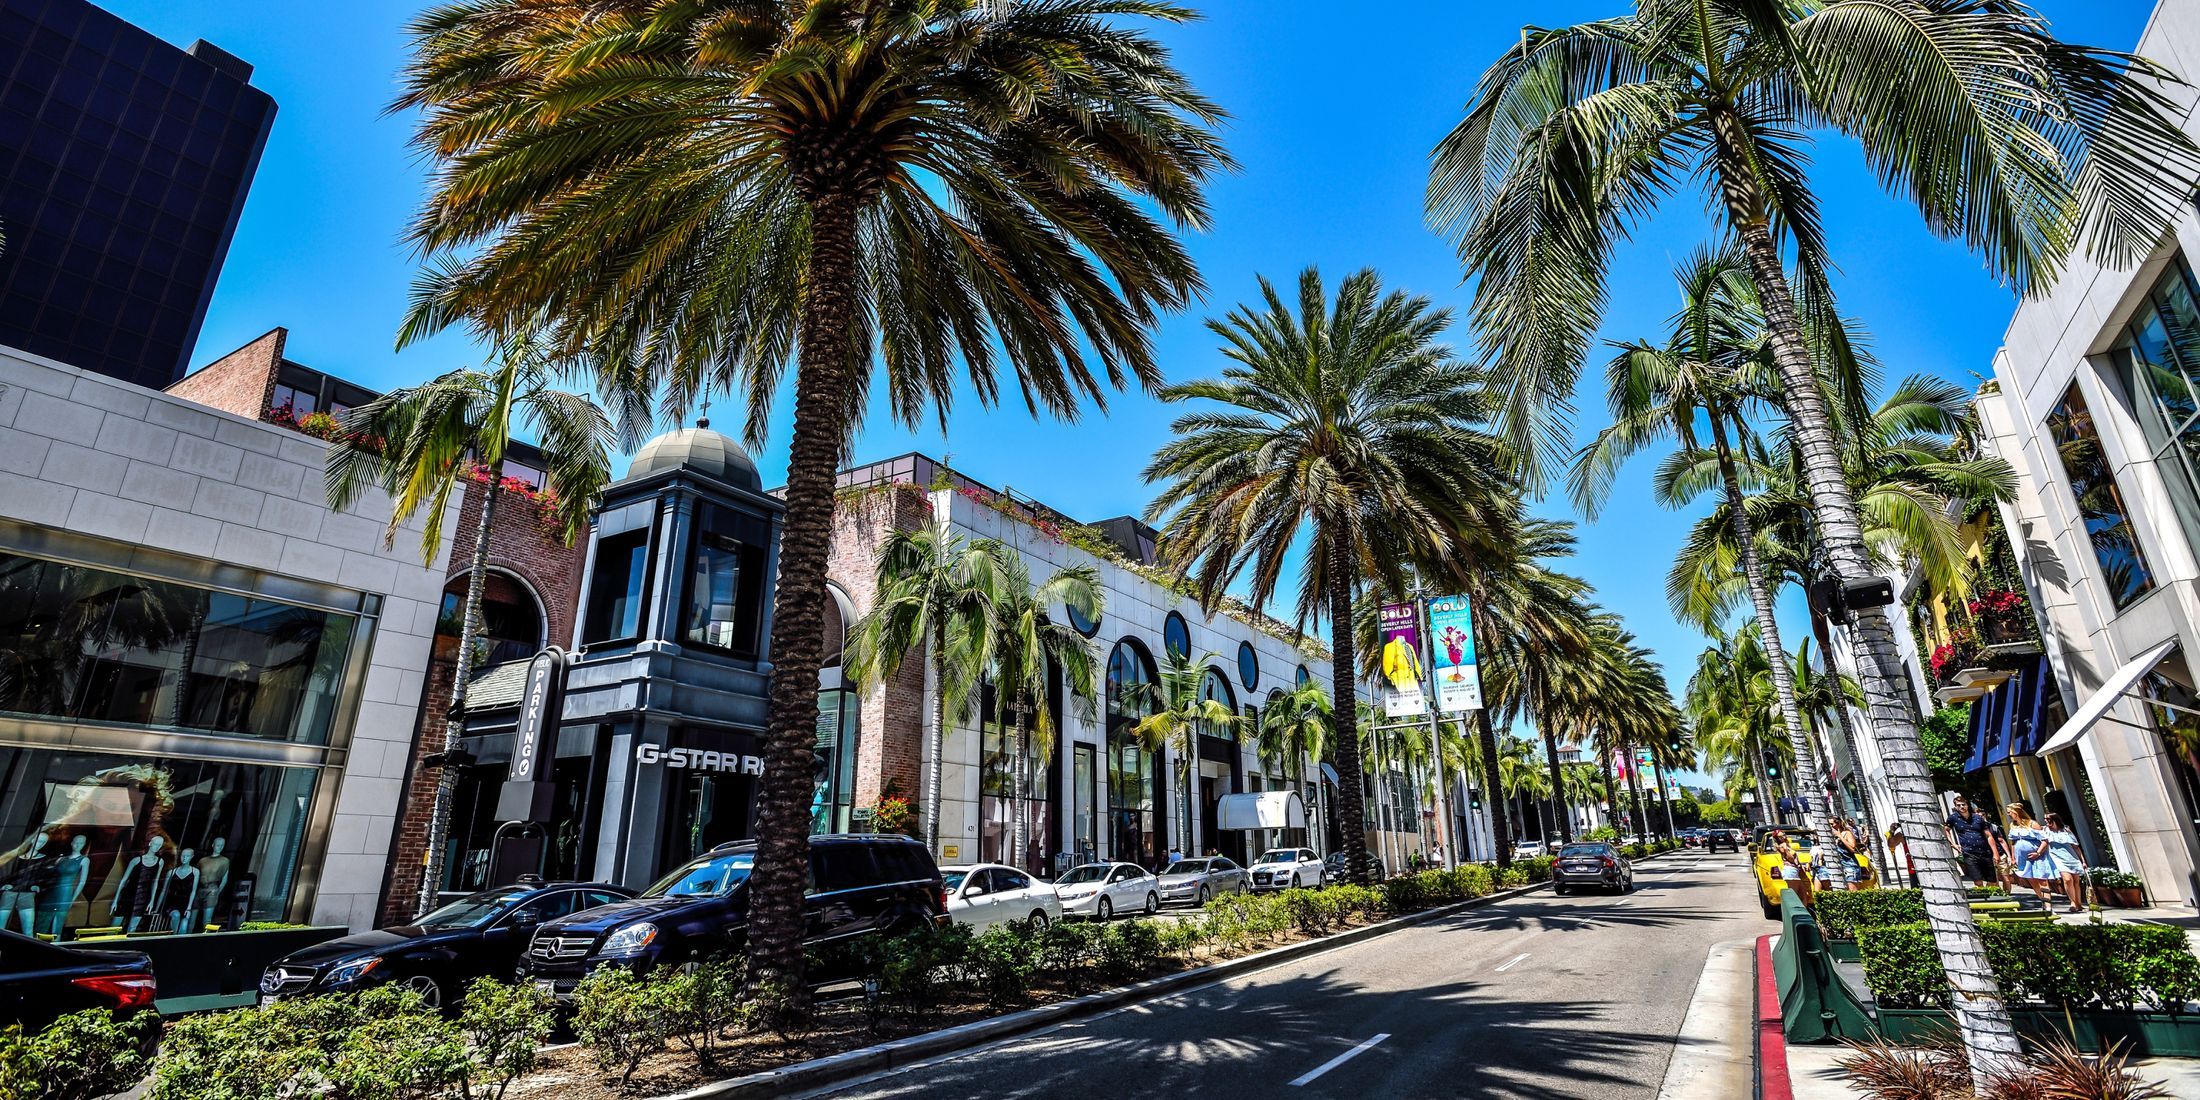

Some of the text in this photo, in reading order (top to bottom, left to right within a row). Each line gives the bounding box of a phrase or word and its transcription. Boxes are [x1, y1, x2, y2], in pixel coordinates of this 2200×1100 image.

[1381, 608, 1412, 621] BOLD
[1433, 602, 1467, 614] BOLD
[521, 670, 545, 757] PARKING
[636, 742, 738, 773] G-STAR
